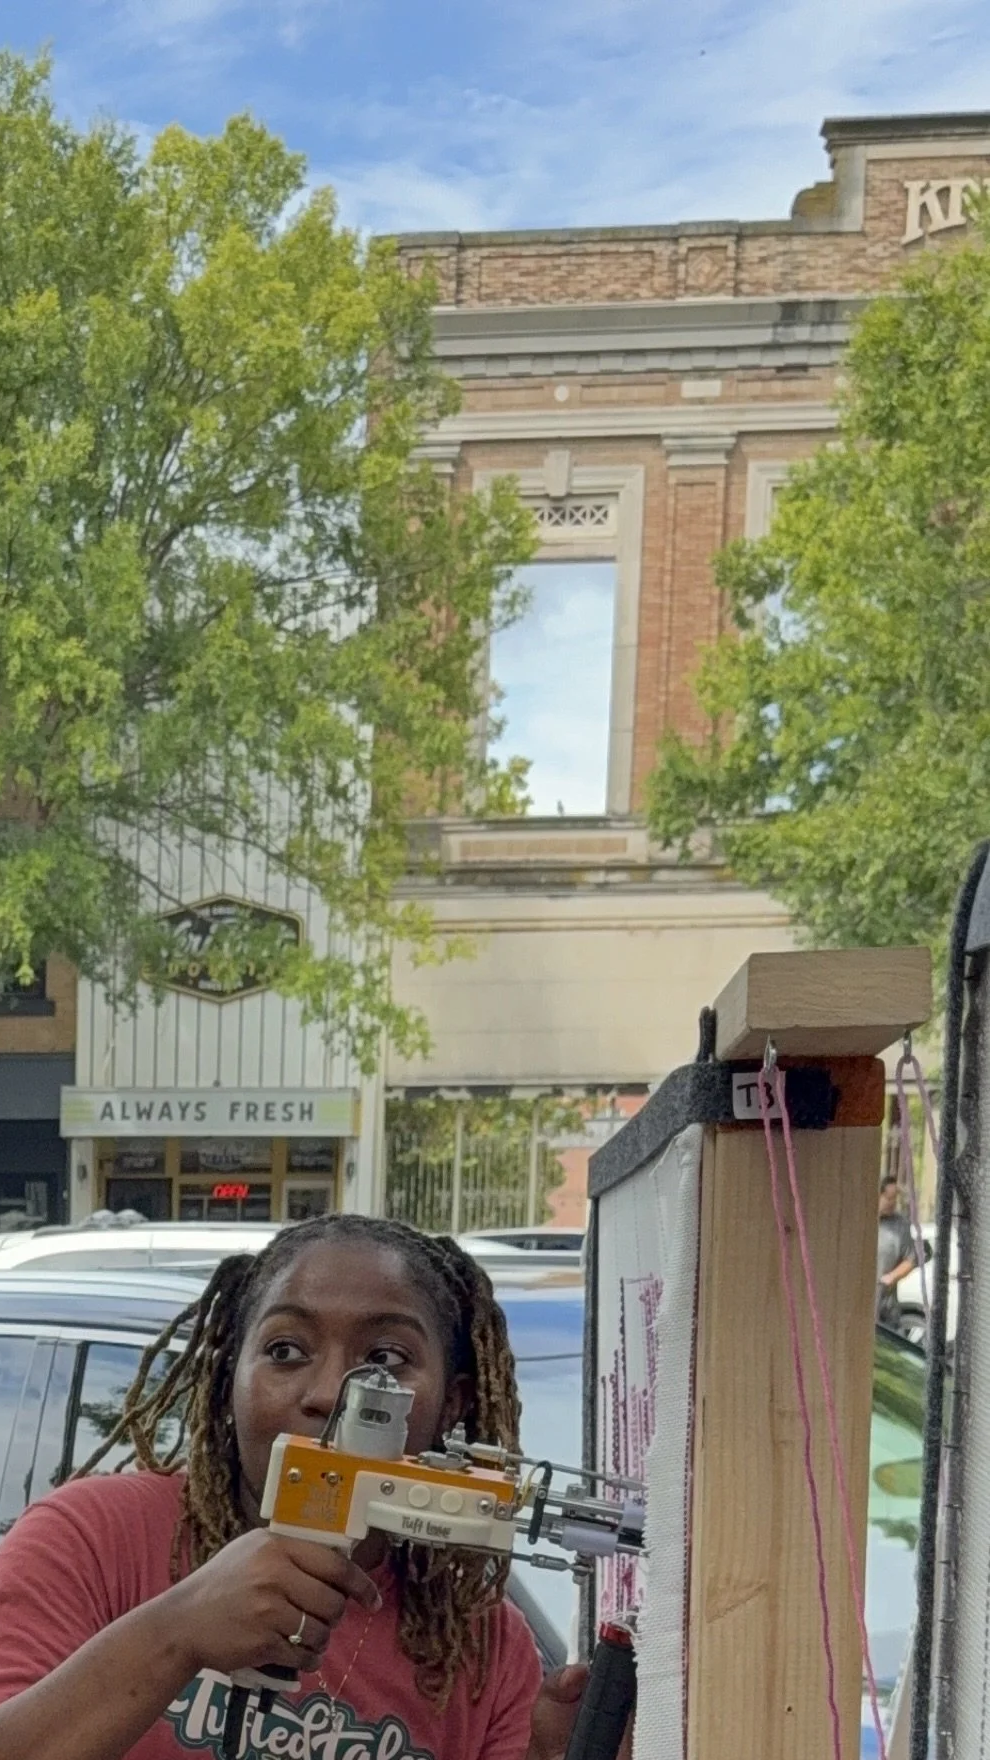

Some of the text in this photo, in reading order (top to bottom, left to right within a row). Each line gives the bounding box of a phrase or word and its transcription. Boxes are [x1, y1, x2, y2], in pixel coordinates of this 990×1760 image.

[100, 1101, 315, 1122] ALWAYS FRESH
[213, 1183, 249, 1199] OPEN
[401, 1515, 424, 1534] Tuft
